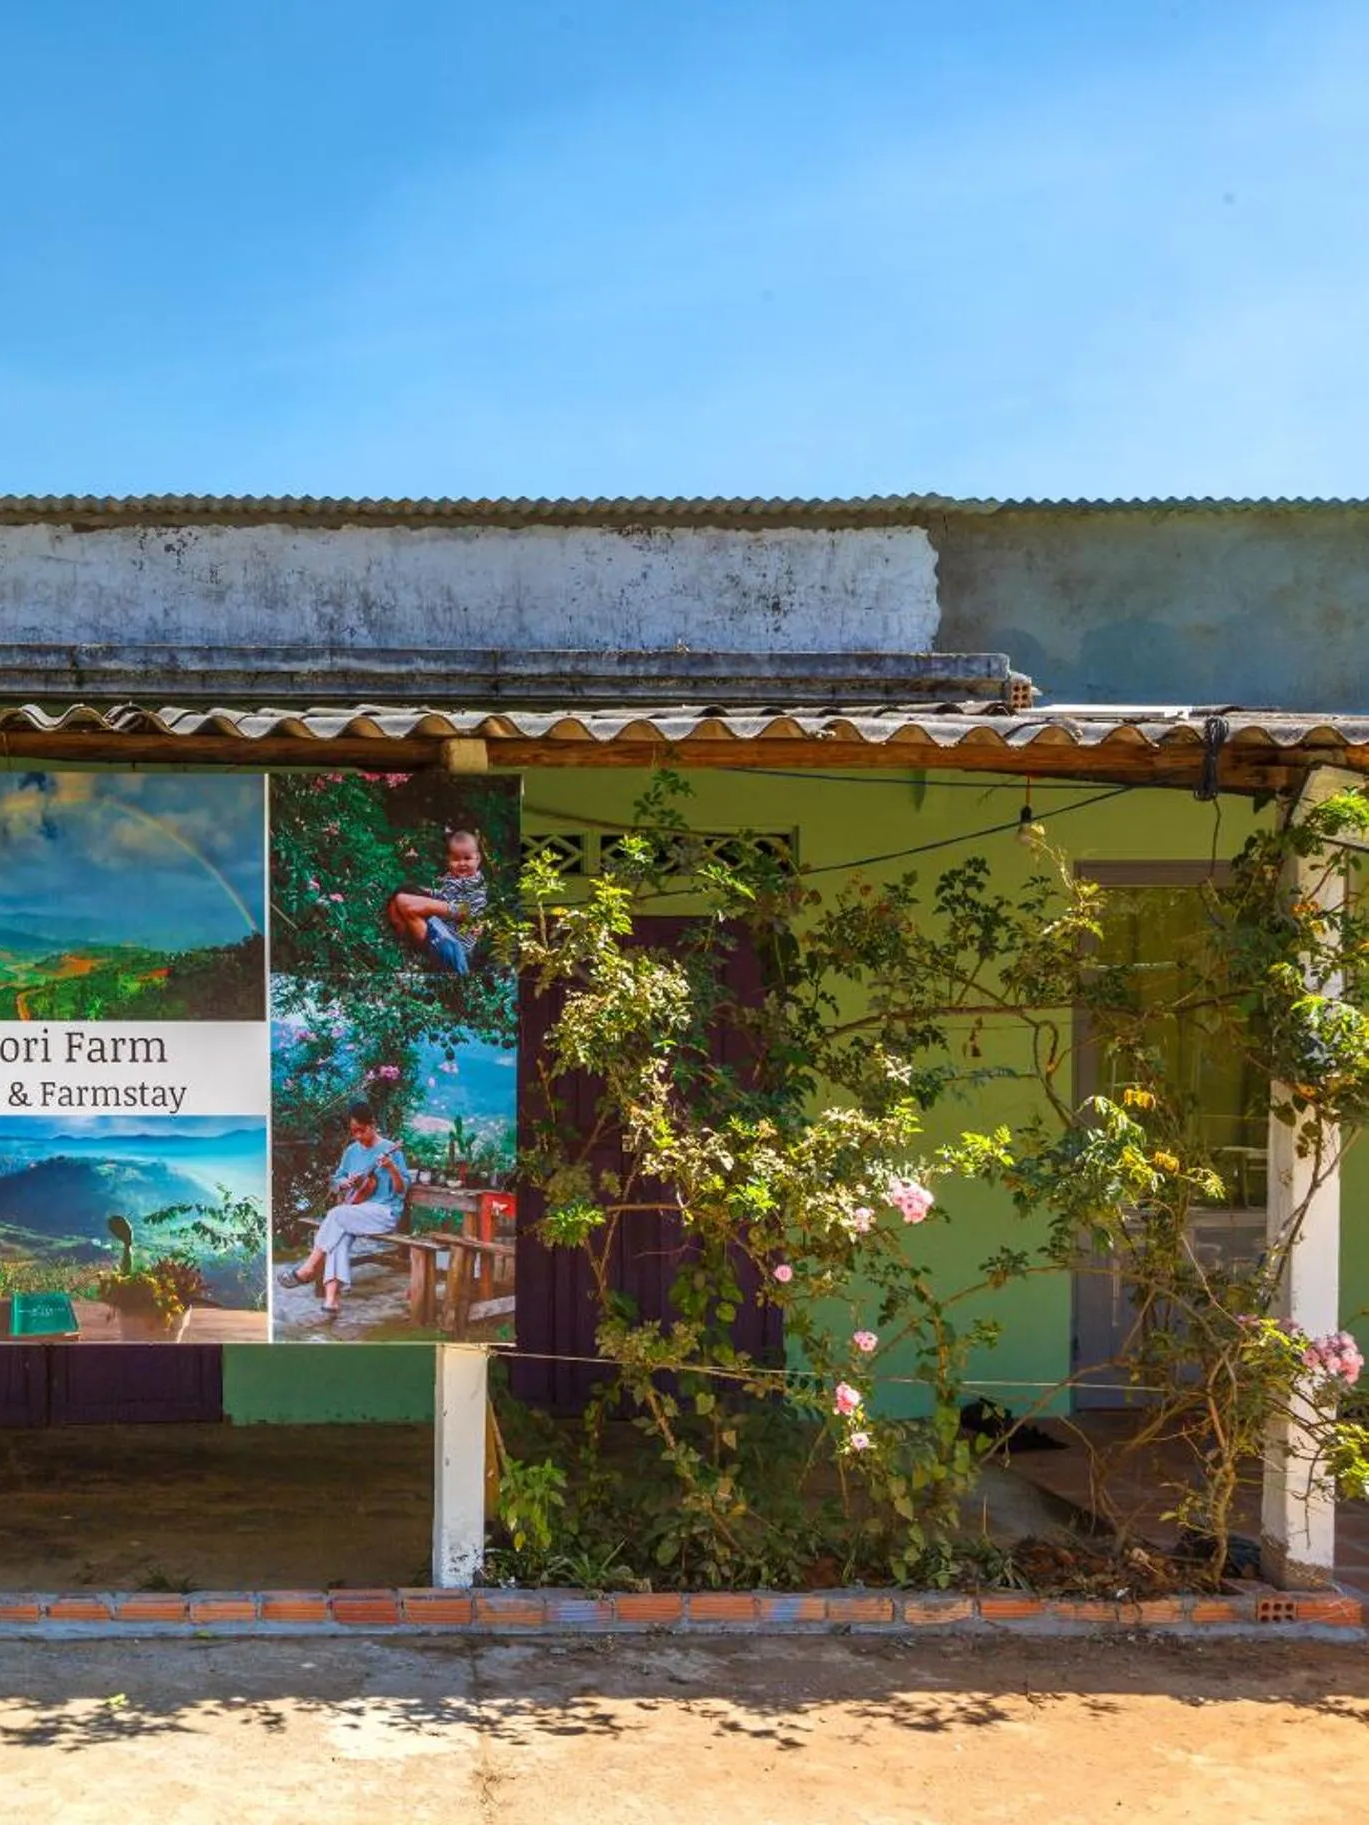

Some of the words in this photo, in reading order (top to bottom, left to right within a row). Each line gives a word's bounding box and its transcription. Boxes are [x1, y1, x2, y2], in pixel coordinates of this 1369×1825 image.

[64, 1031, 168, 1063] Farm
[8, 1081, 33, 1107] &
[40, 1080, 188, 1114] Farmstay
